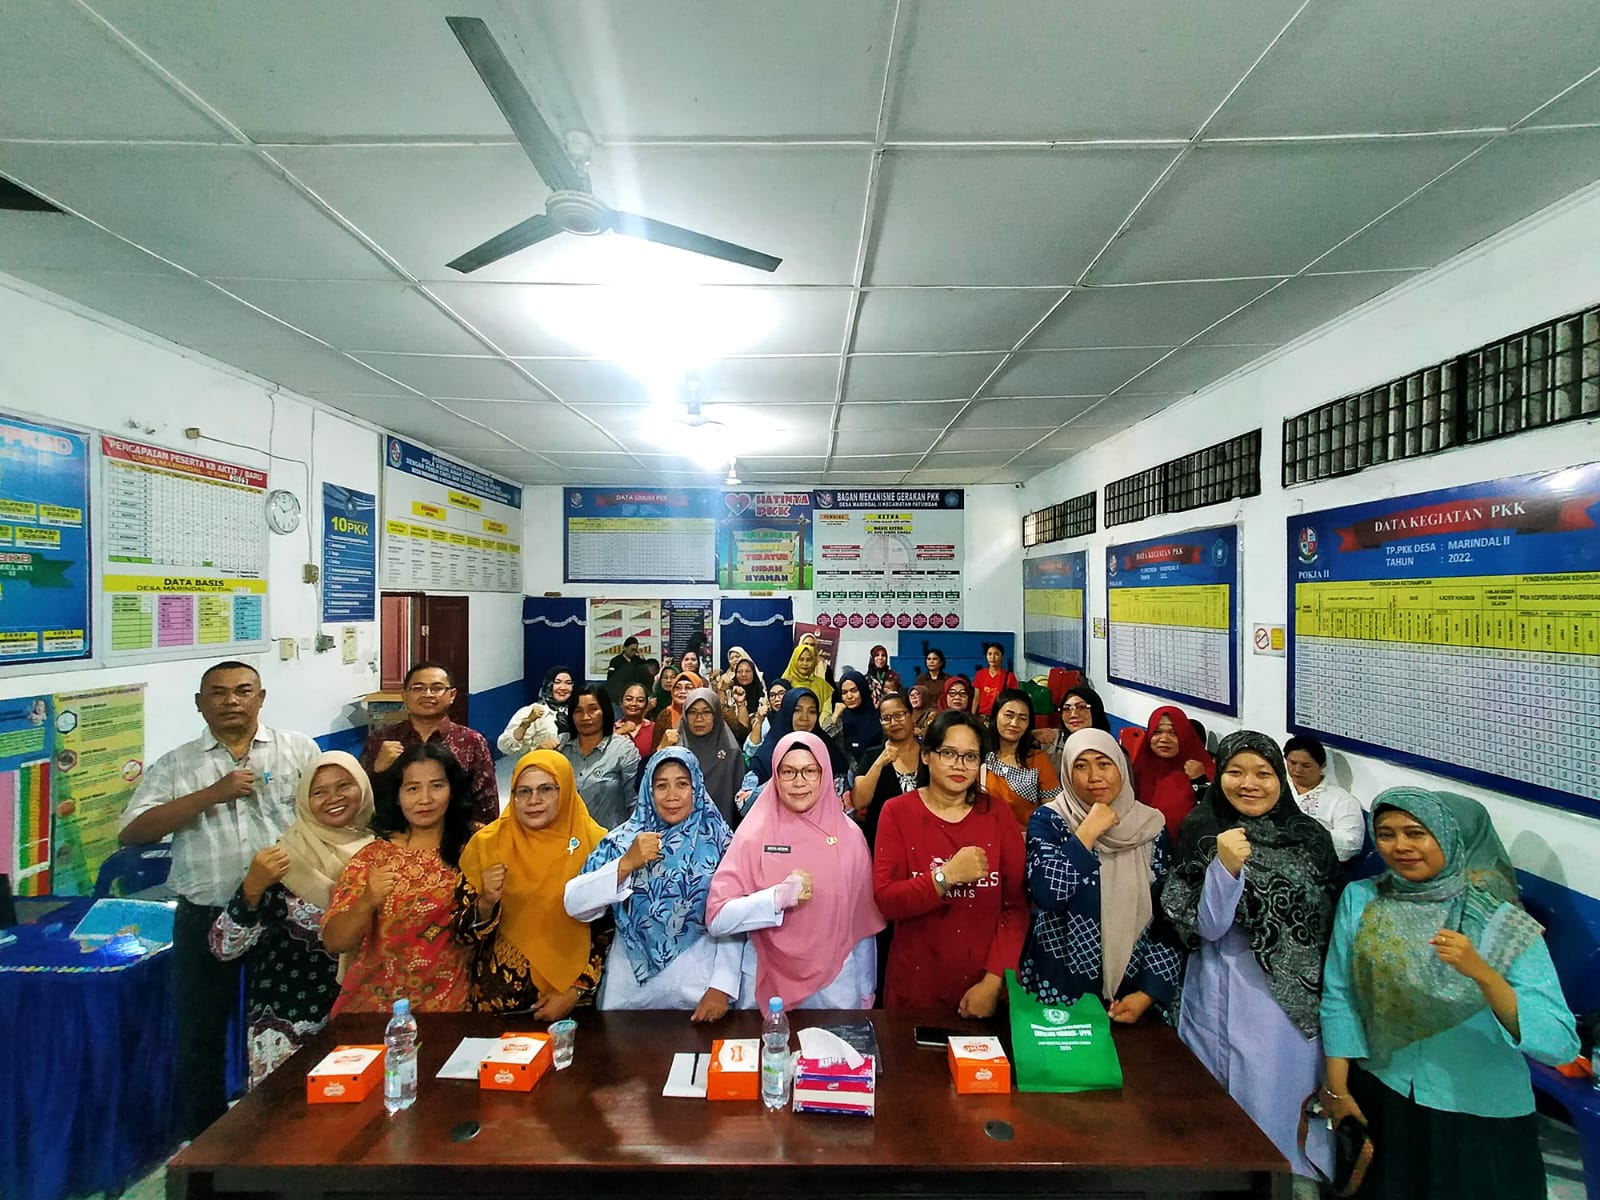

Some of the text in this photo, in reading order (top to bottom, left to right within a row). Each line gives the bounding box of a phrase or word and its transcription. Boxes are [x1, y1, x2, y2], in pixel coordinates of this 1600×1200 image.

[110, 439, 168, 460] PENCAPAIAN
[170, 454, 205, 468] PESERTA
[217, 465, 238, 475] AKTIF
[244, 471, 262, 480] BARU
[755, 494, 810, 506] HATINYA
[837, 492, 940, 501] BAGAN MEKANISME GERAKAN PKK
[756, 506, 790, 517] PKK
[1375, 501, 1526, 532] DATA KEGIATAN PKK
[332, 516, 368, 536] 10 PKK
[1386, 544, 1413, 555] TP.PKK
[1414, 542, 1436, 552] DESA
[1448, 537, 1501, 550] MARINDAL
[1503, 536, 1510, 546] II
[1386, 557, 1414, 567] TAHUN
[946, 889, 976, 898] ARIS
